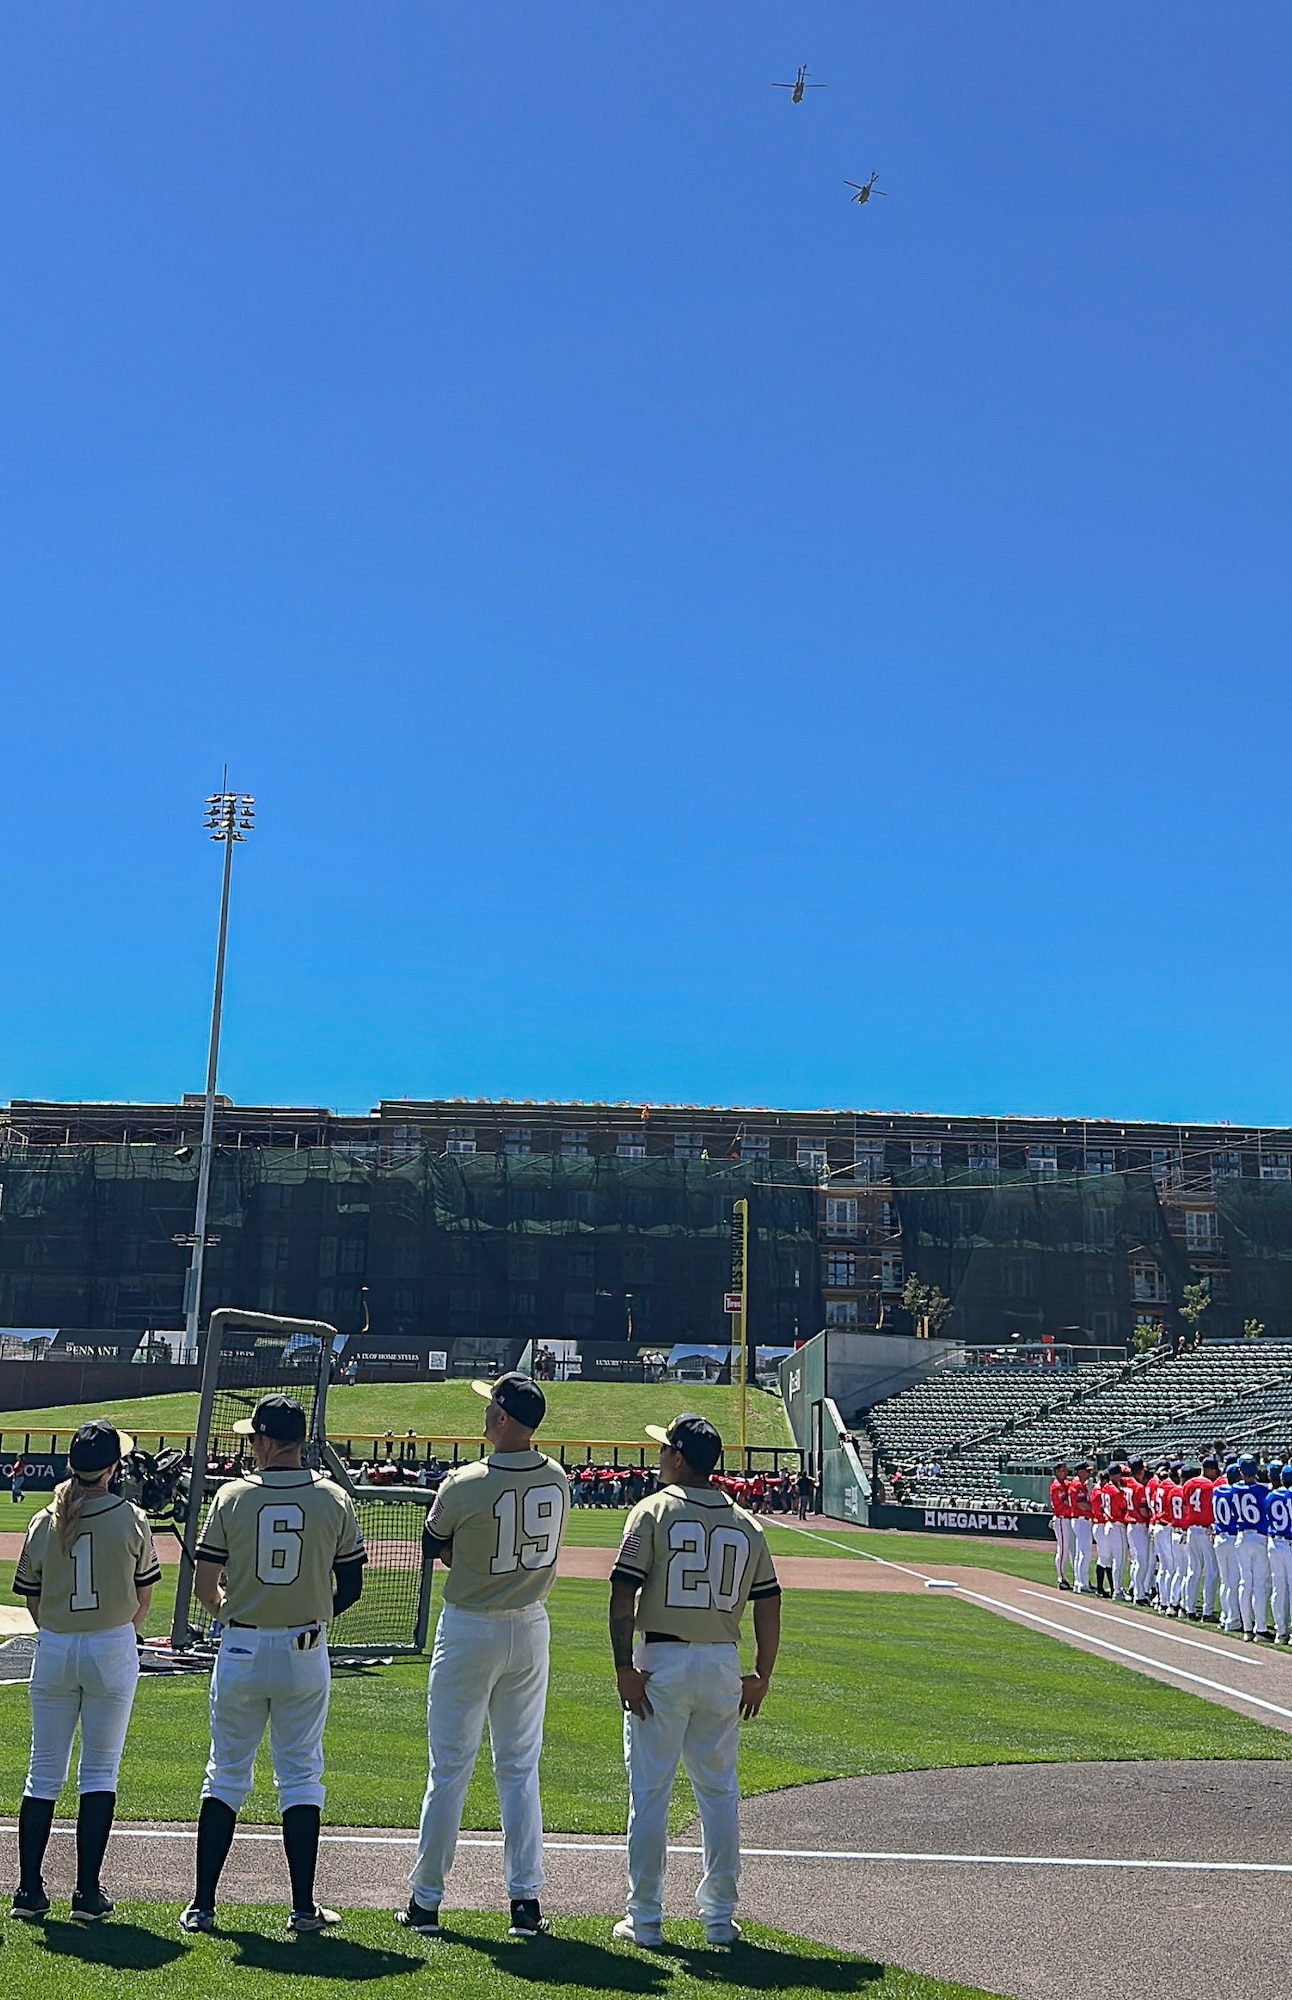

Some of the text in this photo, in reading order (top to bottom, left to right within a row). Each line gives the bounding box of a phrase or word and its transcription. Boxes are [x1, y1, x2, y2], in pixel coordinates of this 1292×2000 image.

[732, 1213, 743, 1267] SCHWAB
[0, 1464, 55, 1477] OOTA
[937, 1511, 1019, 1531] MEGAPLEX
[1172, 1496, 1183, 1520] 8
[1189, 1488, 1201, 1512] 4
[1232, 1493, 1260, 1524] 16
[255, 1503, 305, 1585] 6
[489, 1483, 564, 1575] 19
[70, 1532, 99, 1612] 1
[664, 1520, 750, 1614] 20
